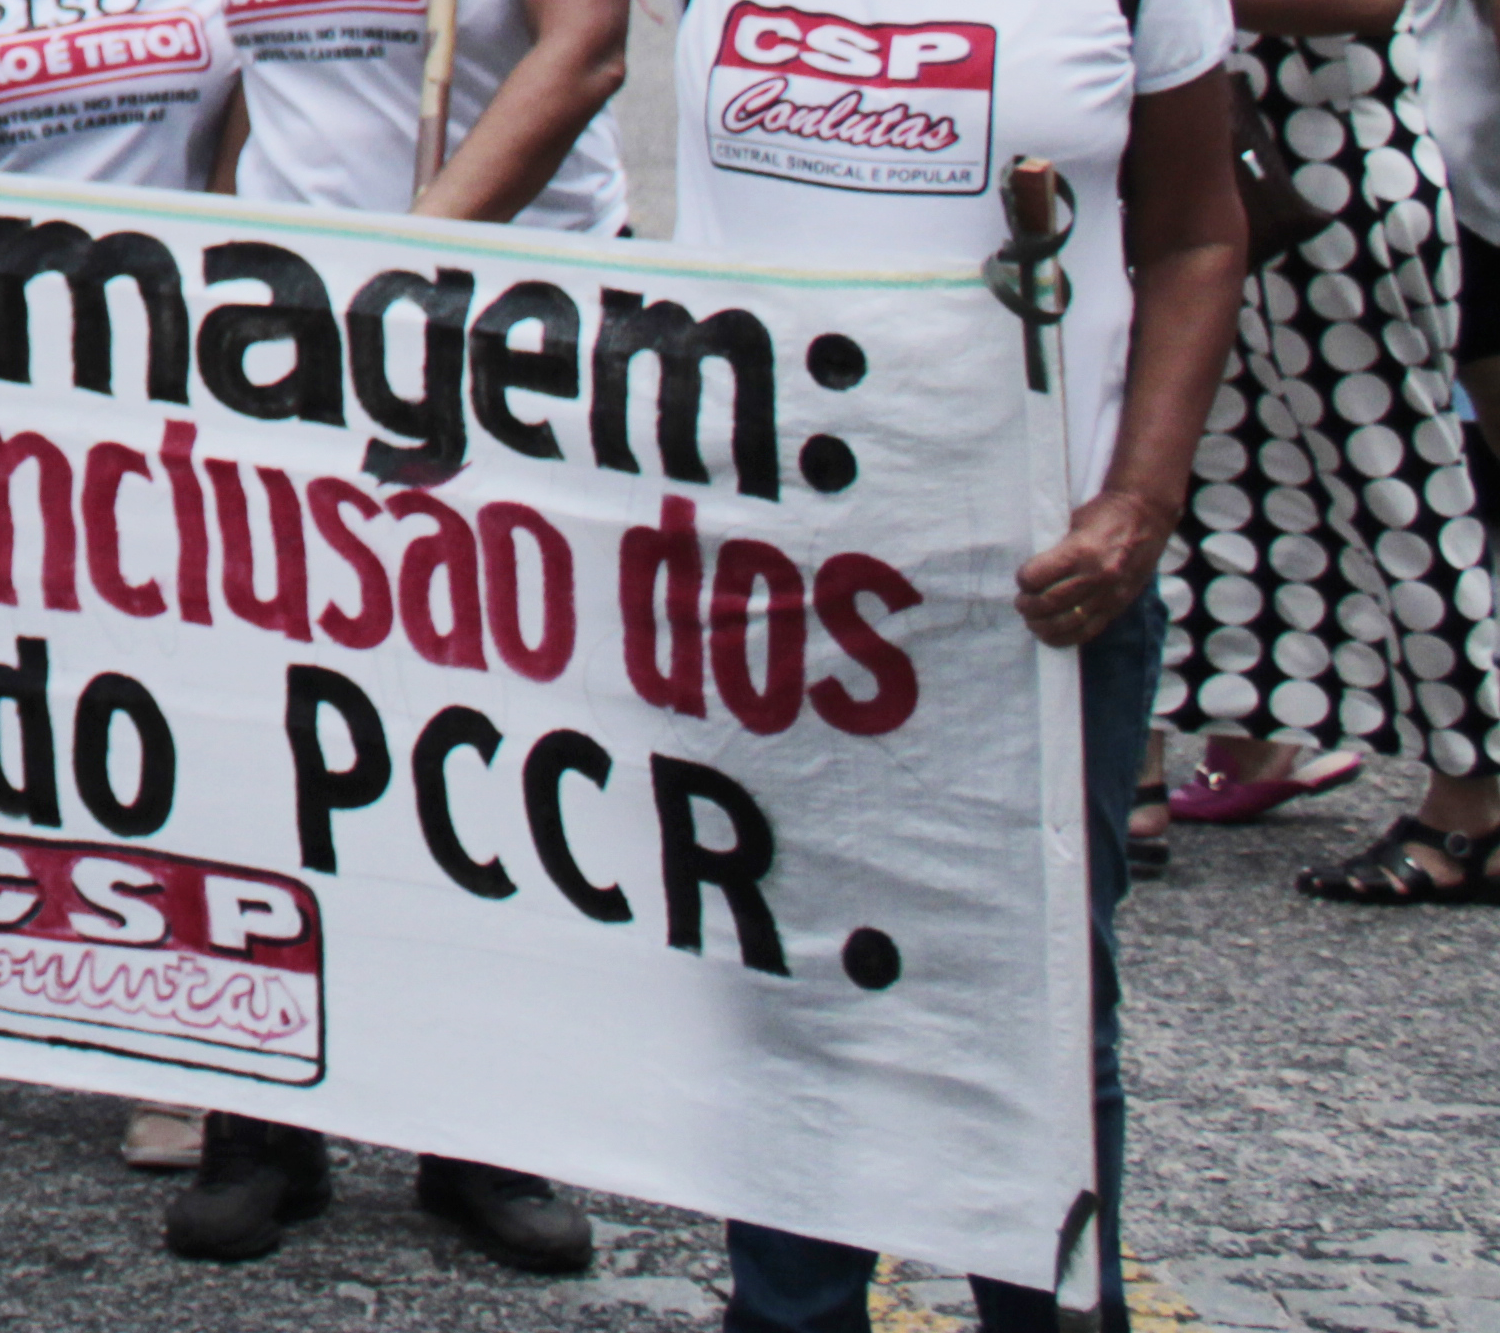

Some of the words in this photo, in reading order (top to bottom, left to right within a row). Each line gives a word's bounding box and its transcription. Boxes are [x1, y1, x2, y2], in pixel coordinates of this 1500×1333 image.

[75, 21, 197, 69] TETO!
[733, 13, 972, 81] CSP
[721, 75, 960, 152] Conlutas
[715, 143, 780, 168] CENTRAL
[786, 154, 864, 181] SINDICAL
[870, 166, 882, 181] E
[887, 168, 973, 184] POPULAR
[618, 495, 923, 735] dos
[284, 662, 902, 991] PCCR.
